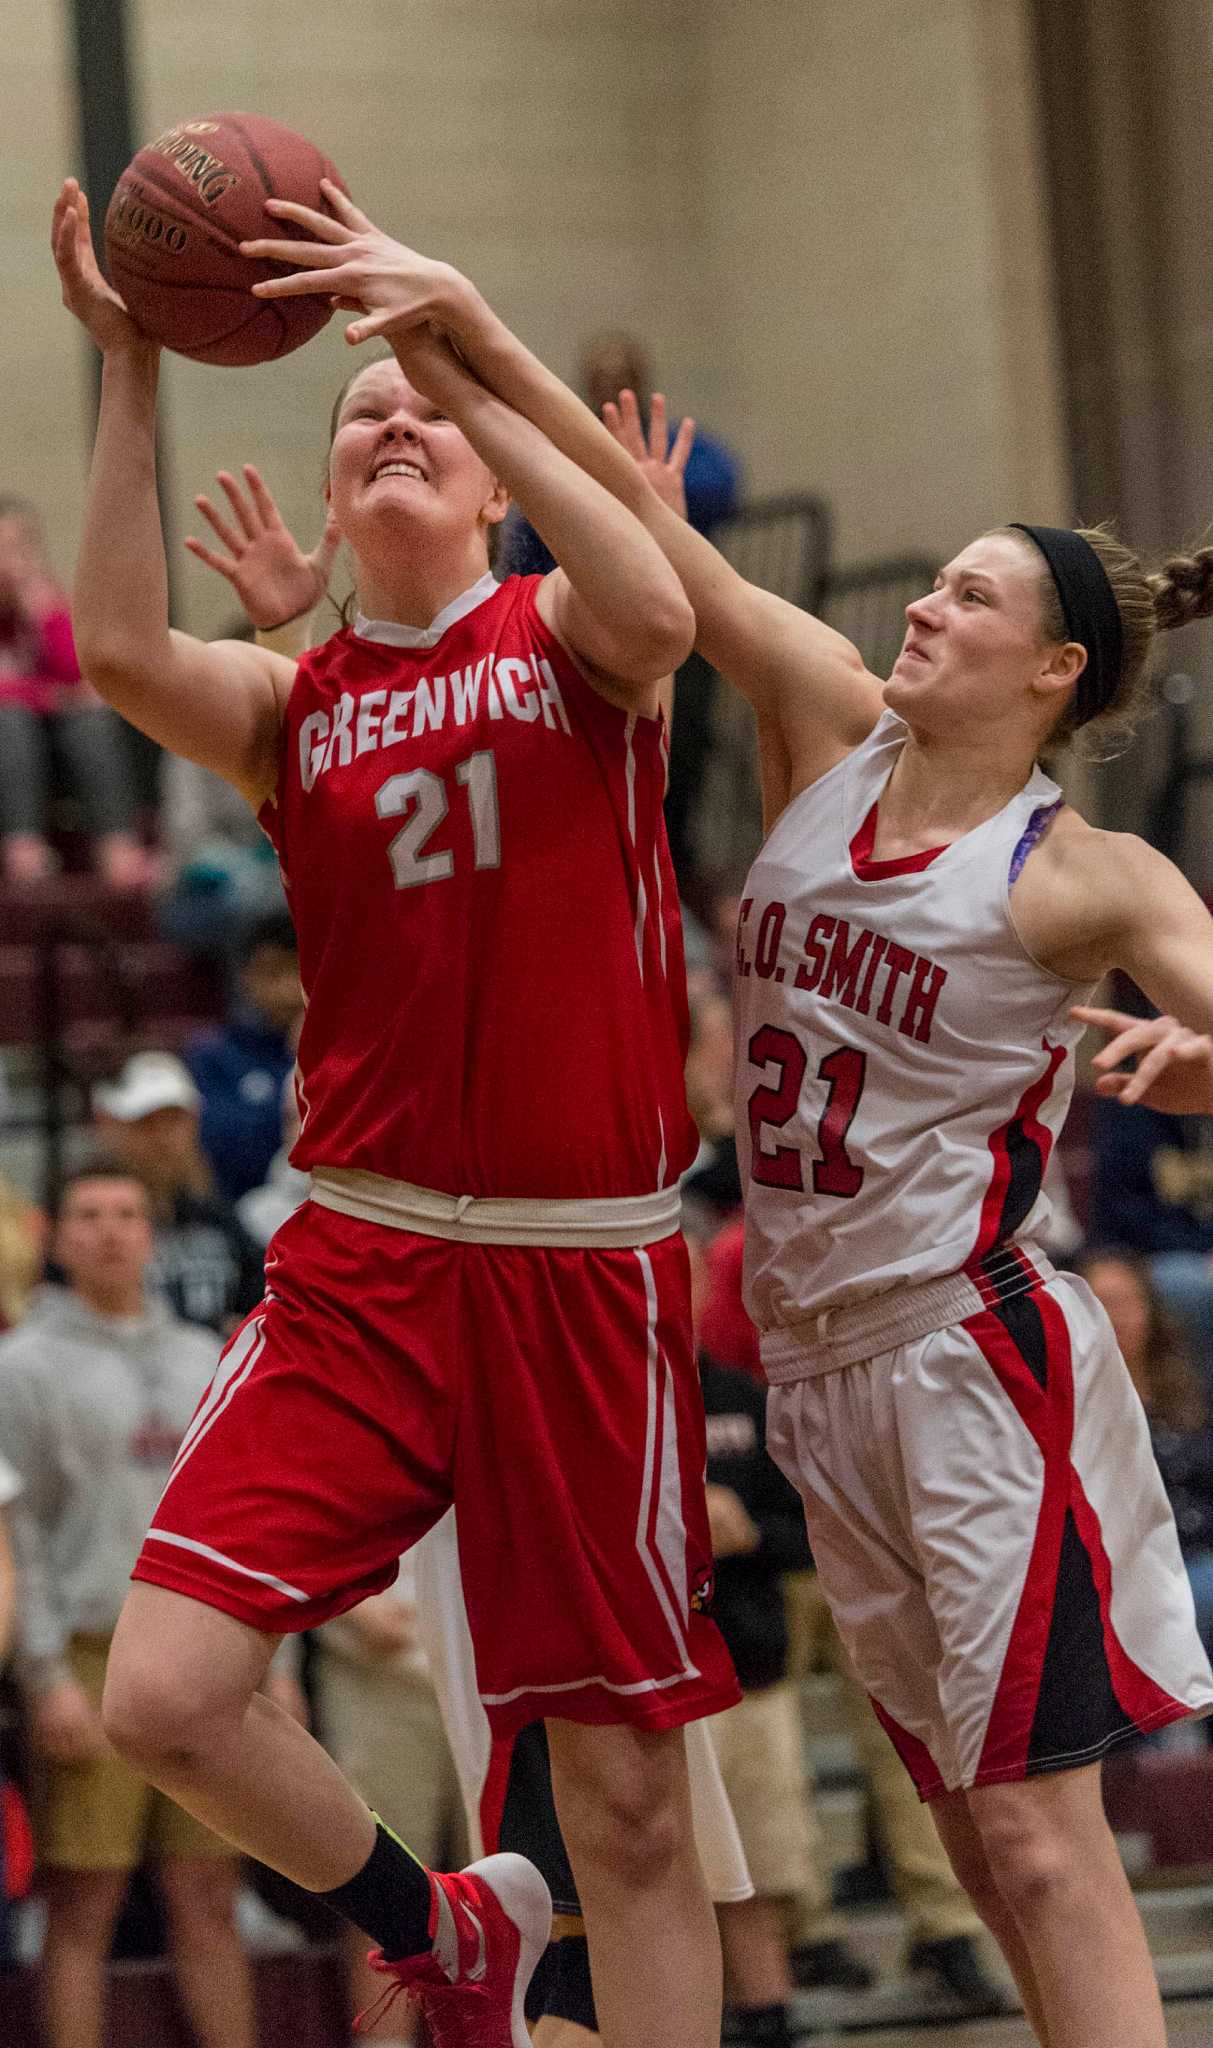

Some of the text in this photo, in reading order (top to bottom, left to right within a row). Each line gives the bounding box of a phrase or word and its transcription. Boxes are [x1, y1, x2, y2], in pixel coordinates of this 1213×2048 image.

[299, 652, 572, 794] GREENWICH
[374, 749, 500, 890] 21
[793, 913, 948, 1044] SMITH
[748, 1023, 867, 1198] 21
